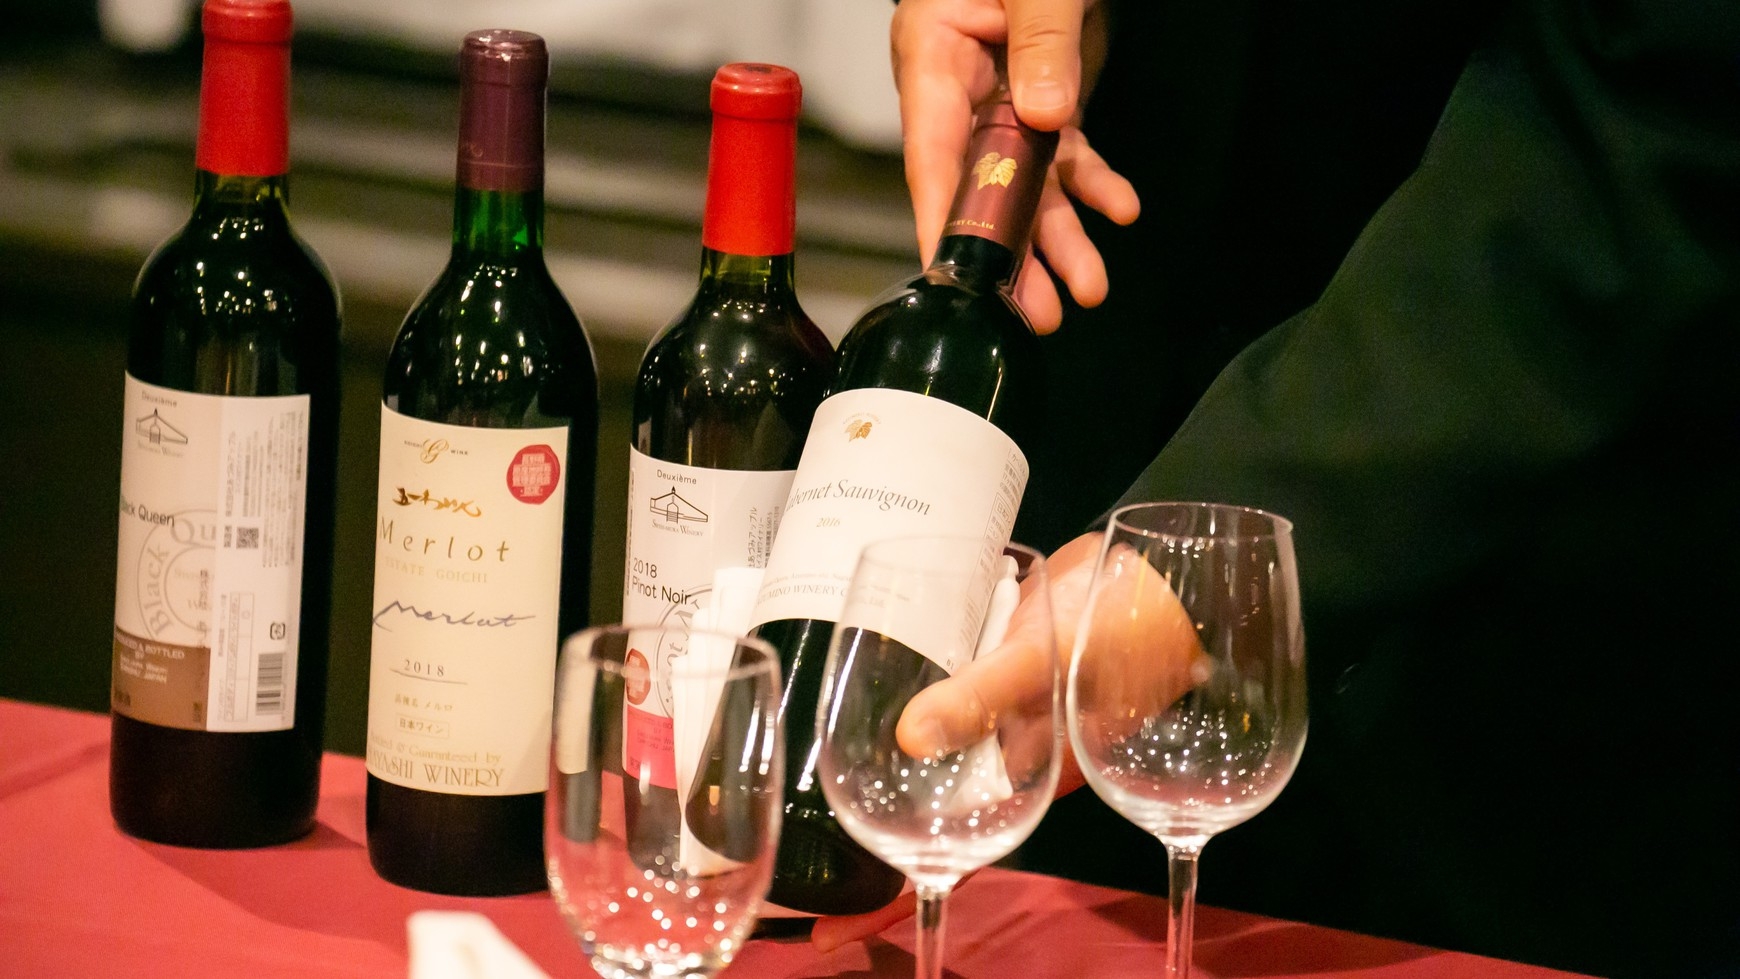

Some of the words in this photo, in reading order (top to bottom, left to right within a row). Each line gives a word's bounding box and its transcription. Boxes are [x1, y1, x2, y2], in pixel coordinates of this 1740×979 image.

[656, 469, 697, 485] Deuxième
[833, 478, 931, 516] Sauvignon
[138, 504, 175, 527] Queen
[378, 516, 510, 562] Merlot
[435, 568, 488, 584] GOICHI
[632, 558, 658, 579] 2018
[632, 575, 657, 599] Pinot
[661, 585, 692, 606] Noir
[793, 584, 838, 596] WINERY
[403, 659, 445, 677] 2018
[399, 717, 444, 734] 日本ワイン
[485, 751, 502, 766] by
[422, 762, 507, 788] WINERY
